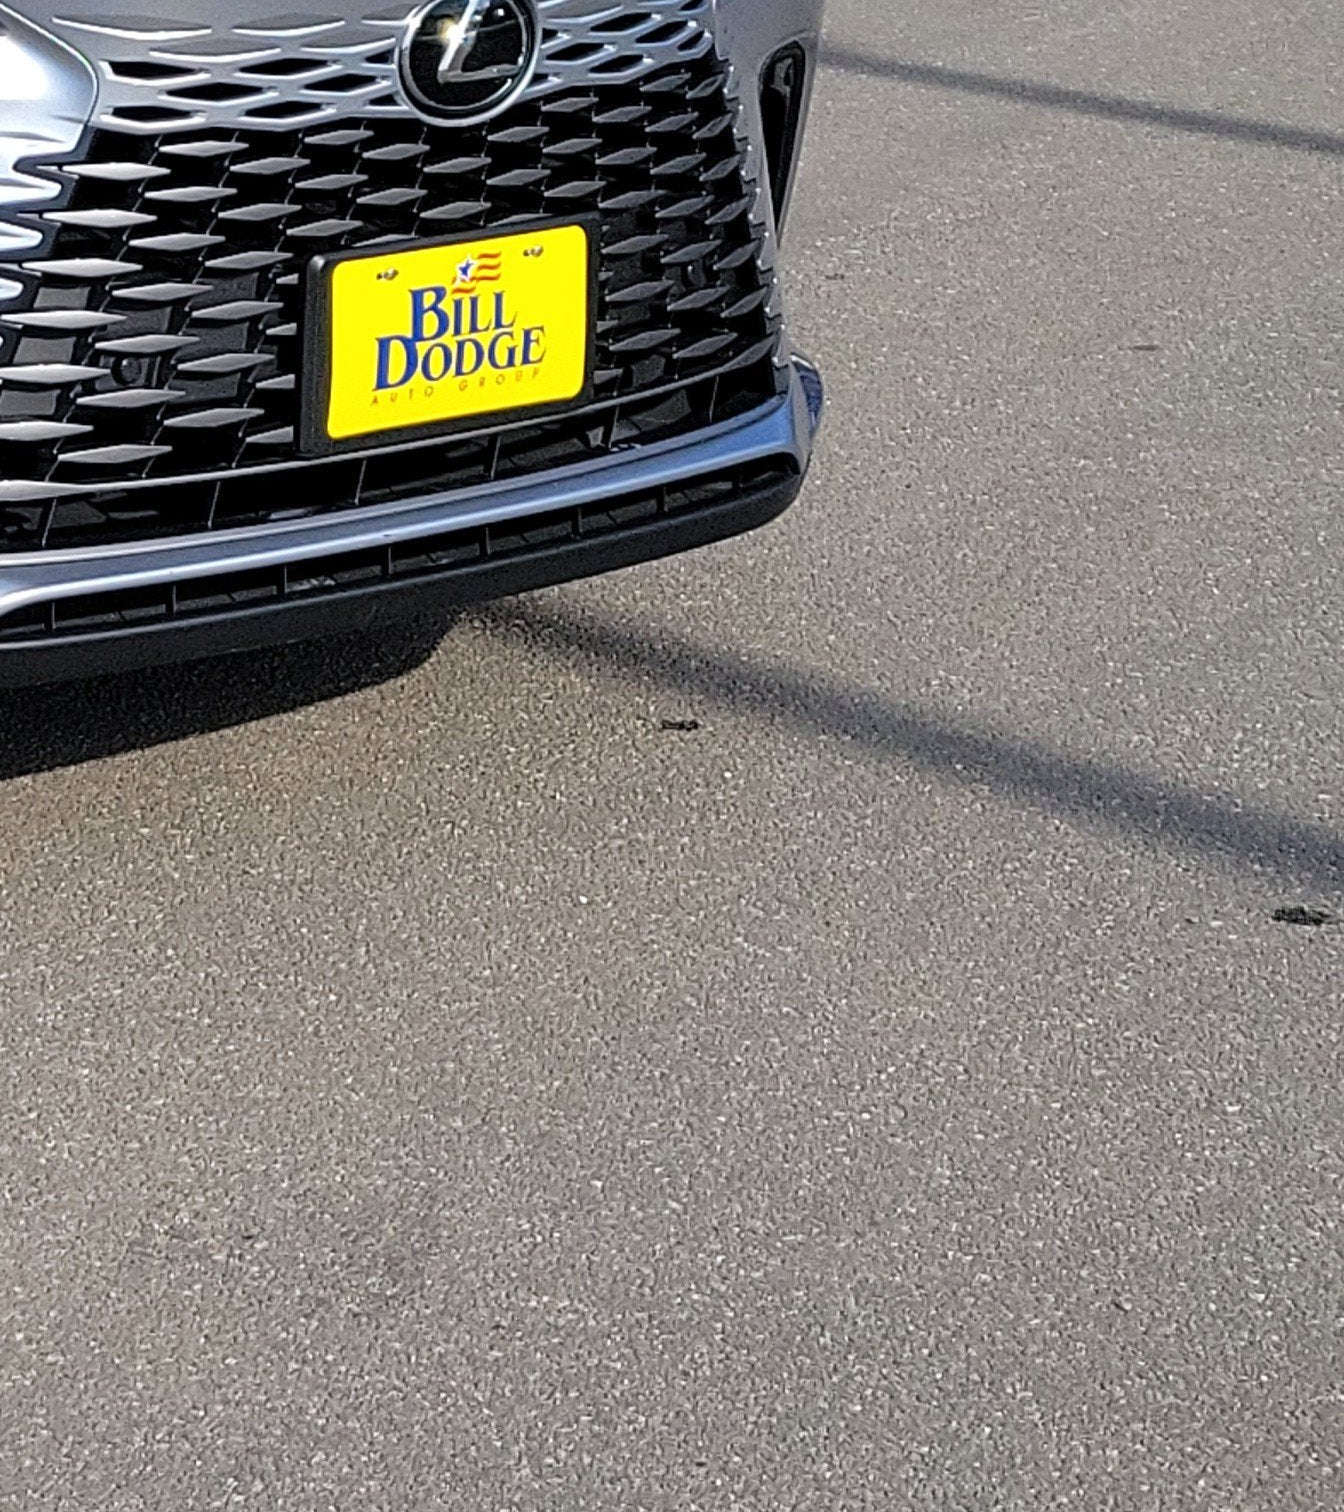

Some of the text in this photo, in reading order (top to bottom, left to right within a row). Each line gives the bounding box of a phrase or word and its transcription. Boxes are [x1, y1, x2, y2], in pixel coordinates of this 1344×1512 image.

[408, 285, 517, 343] BILL
[370, 367, 540, 407] AUTO GROUP
[372, 326, 547, 392] DODGE
